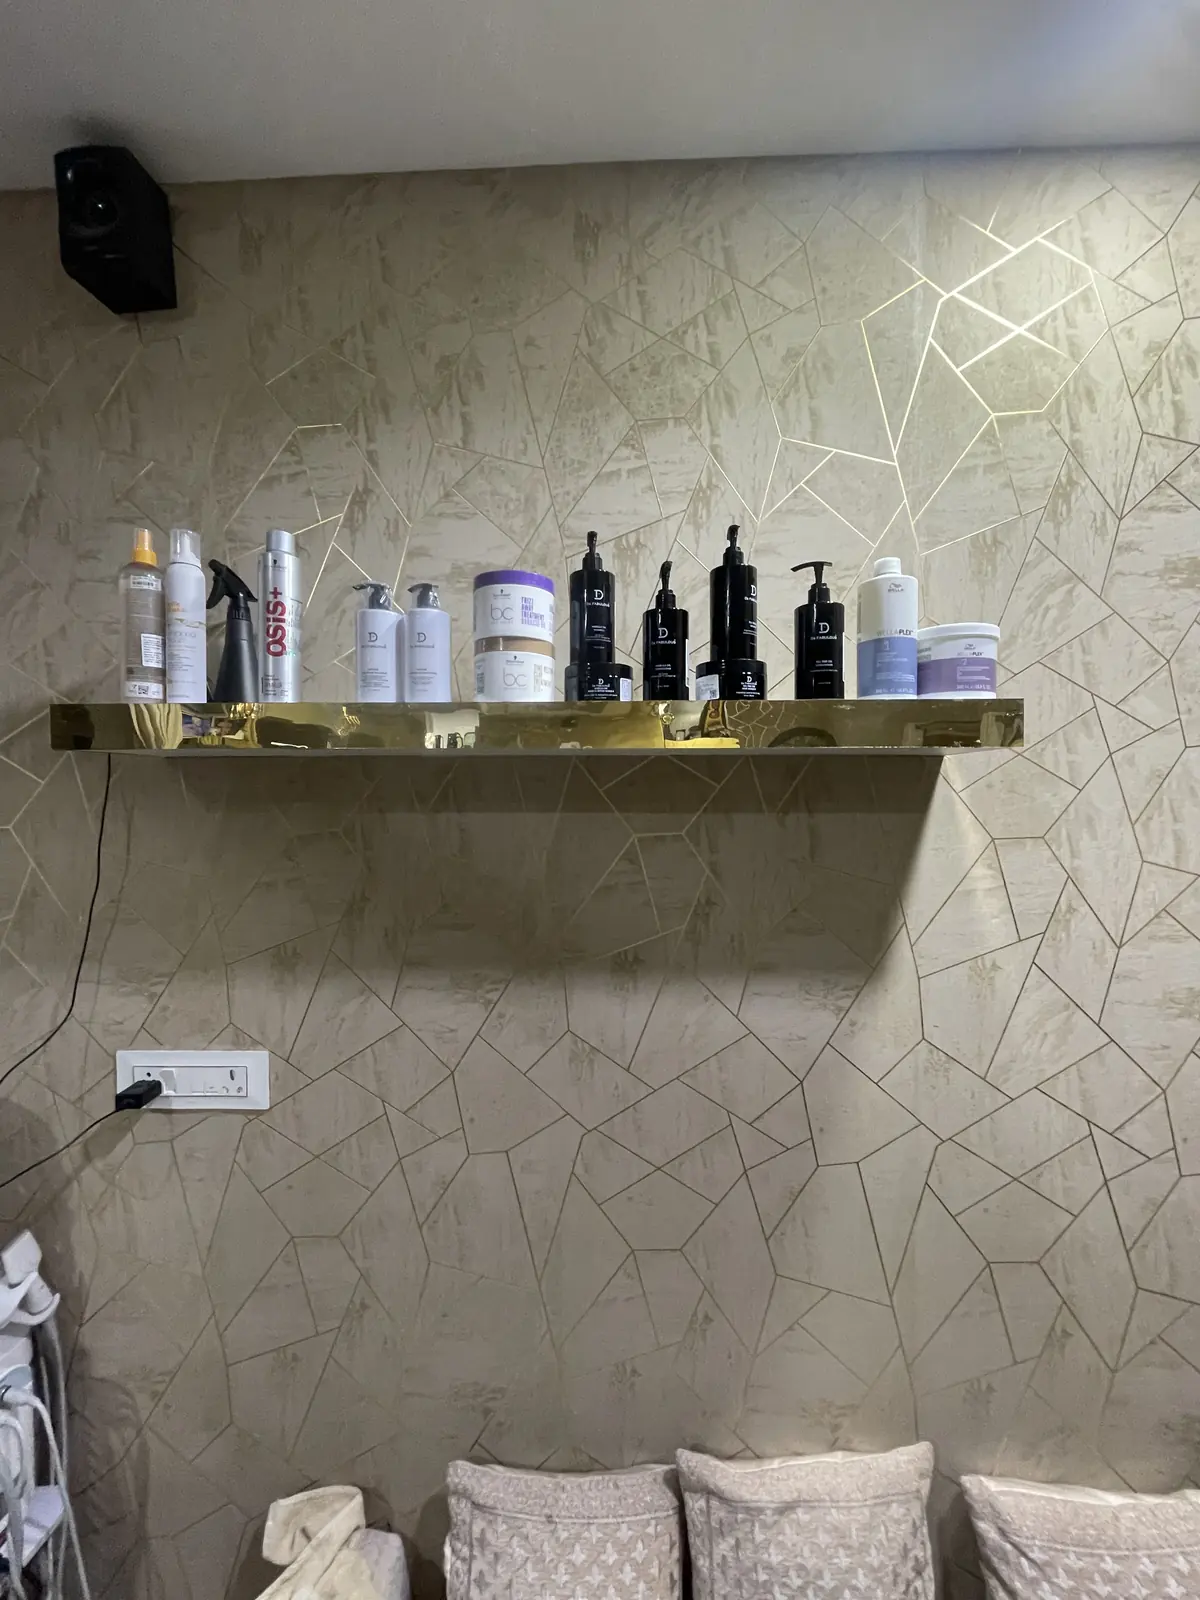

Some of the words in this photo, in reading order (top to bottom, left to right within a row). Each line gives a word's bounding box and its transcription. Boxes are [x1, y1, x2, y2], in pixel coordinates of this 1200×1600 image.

[593, 589, 604, 601] D
[491, 603, 514, 621] bc
[658, 627, 669, 639] D
[818, 622, 830, 634] D
[367, 631, 378, 643] D
[416, 632, 427, 643] D
[502, 666, 527, 687] bc
